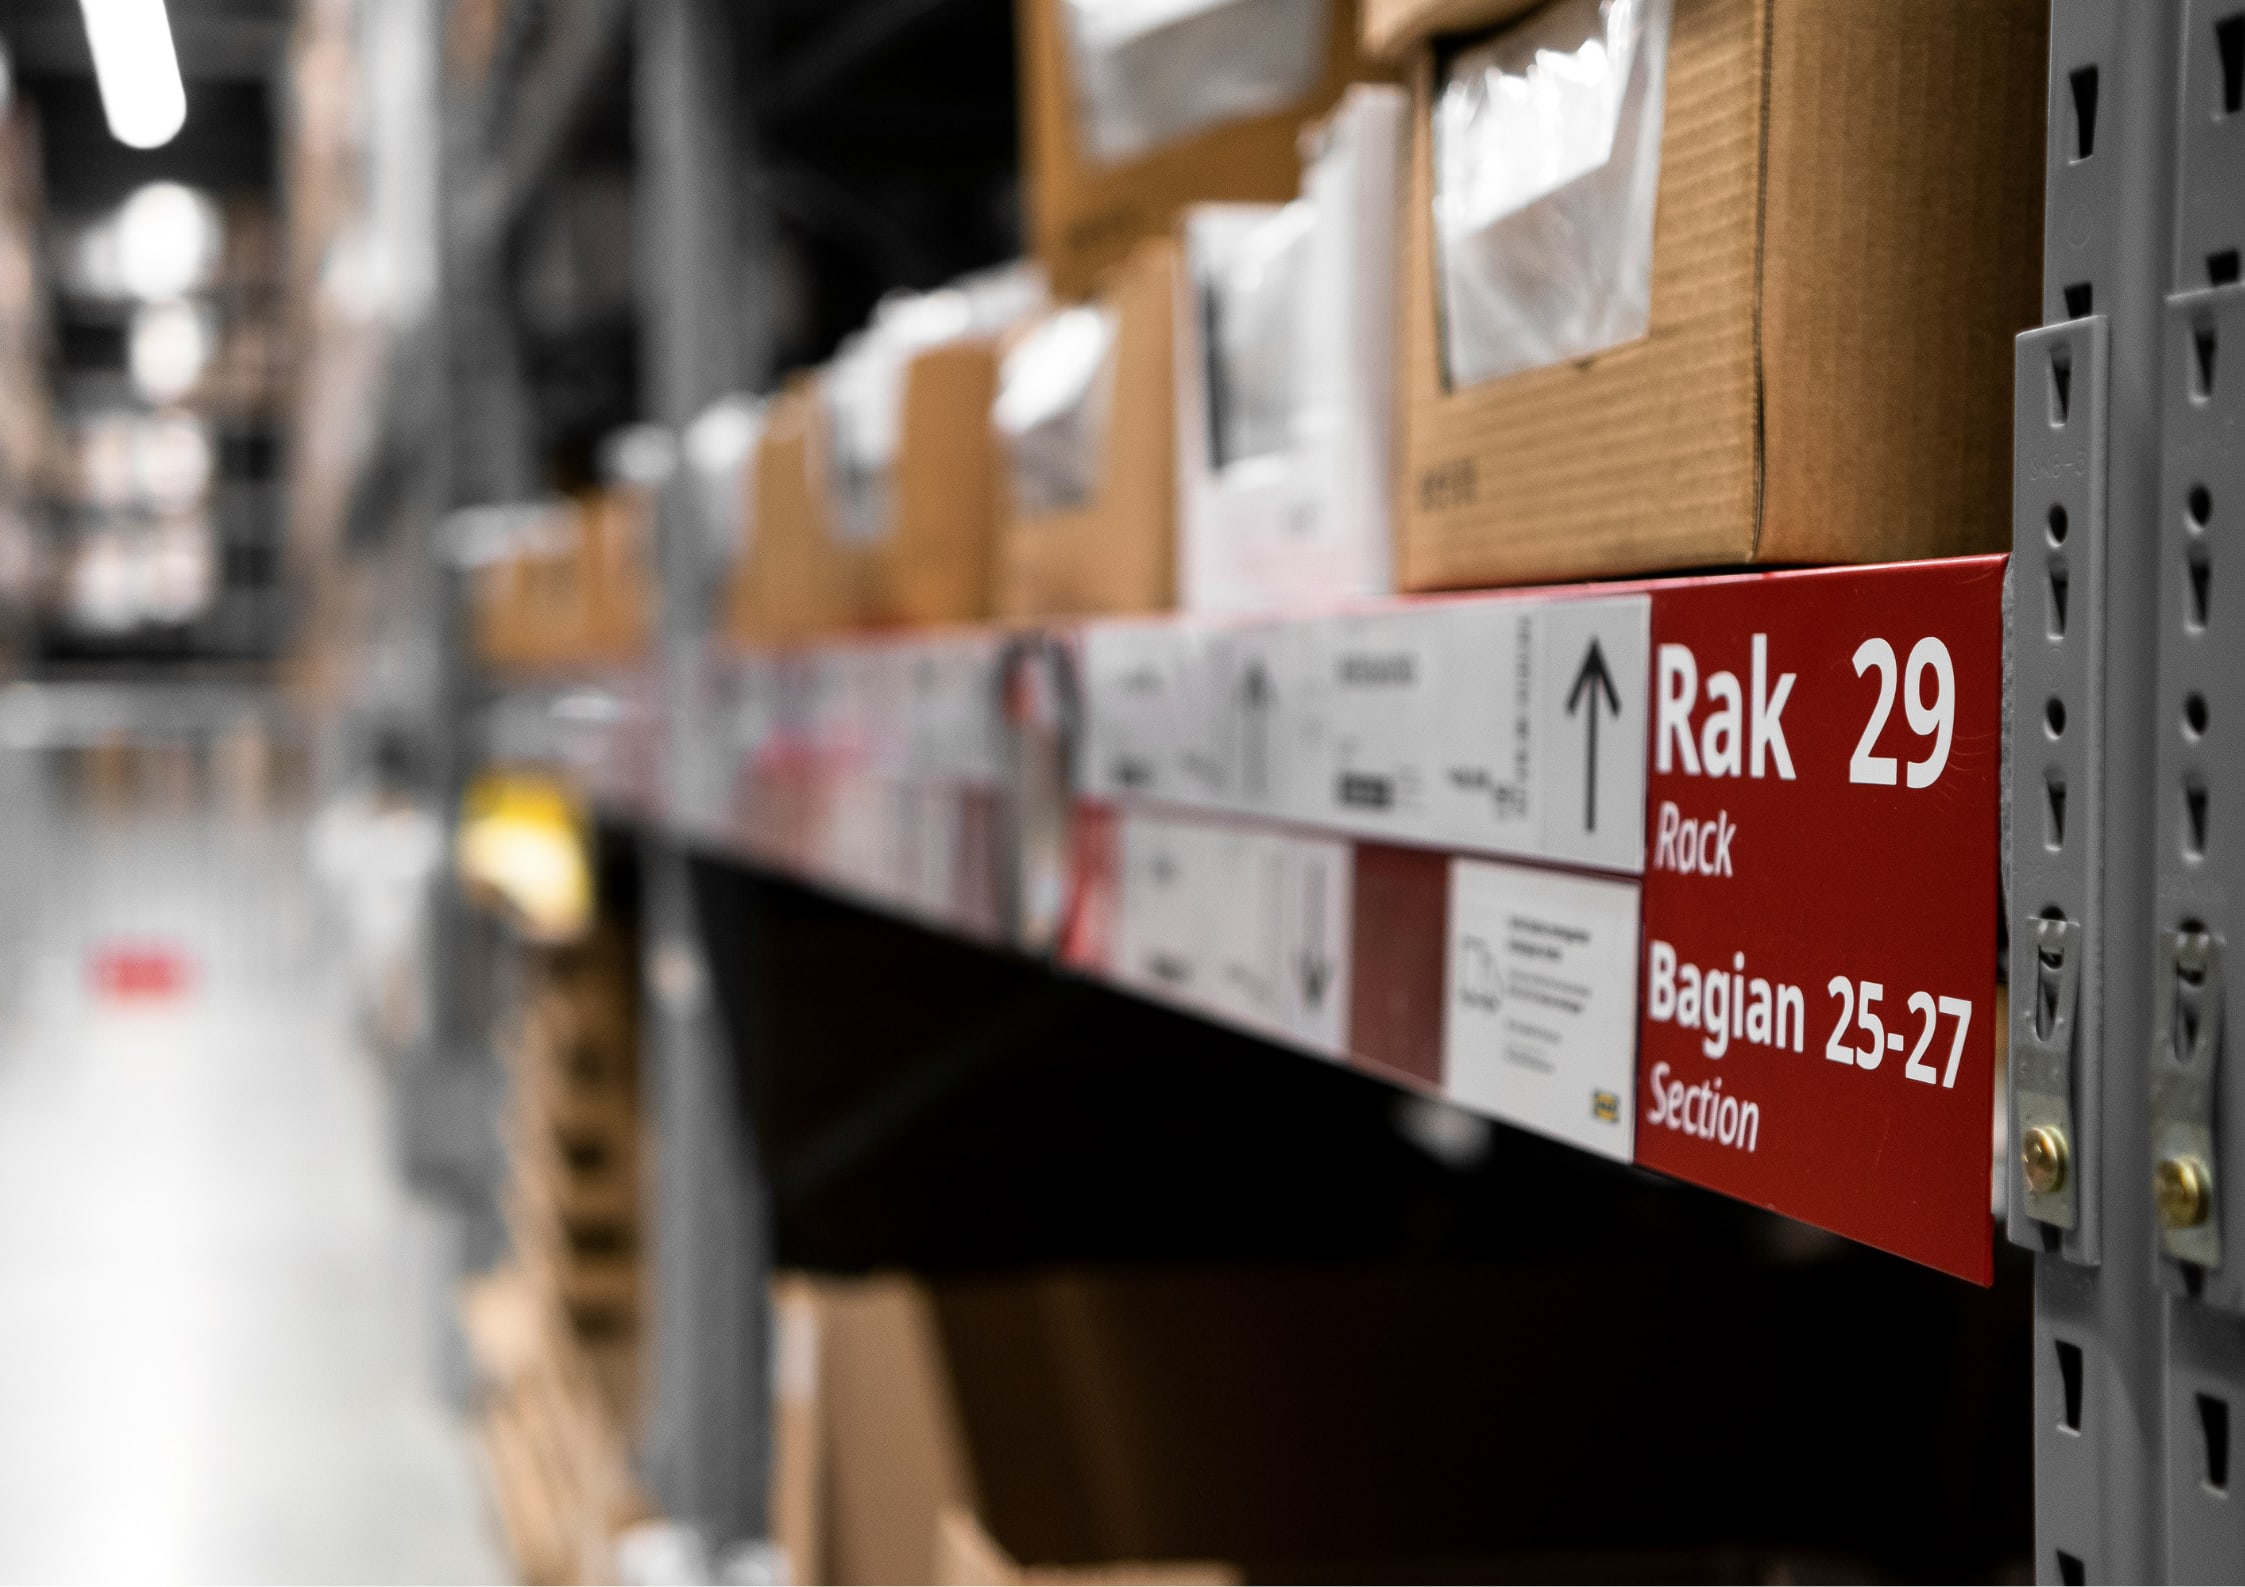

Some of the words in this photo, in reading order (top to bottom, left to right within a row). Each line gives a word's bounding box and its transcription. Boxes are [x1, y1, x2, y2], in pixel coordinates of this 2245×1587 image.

[1656, 633, 1797, 780] Rak
[1849, 637, 1956, 788] 29
[1655, 801, 1737, 877] Rack
[1648, 940, 1804, 1059] Bagian
[1825, 975, 1973, 1089] 25-27
[1646, 1062, 1760, 1152] Section
